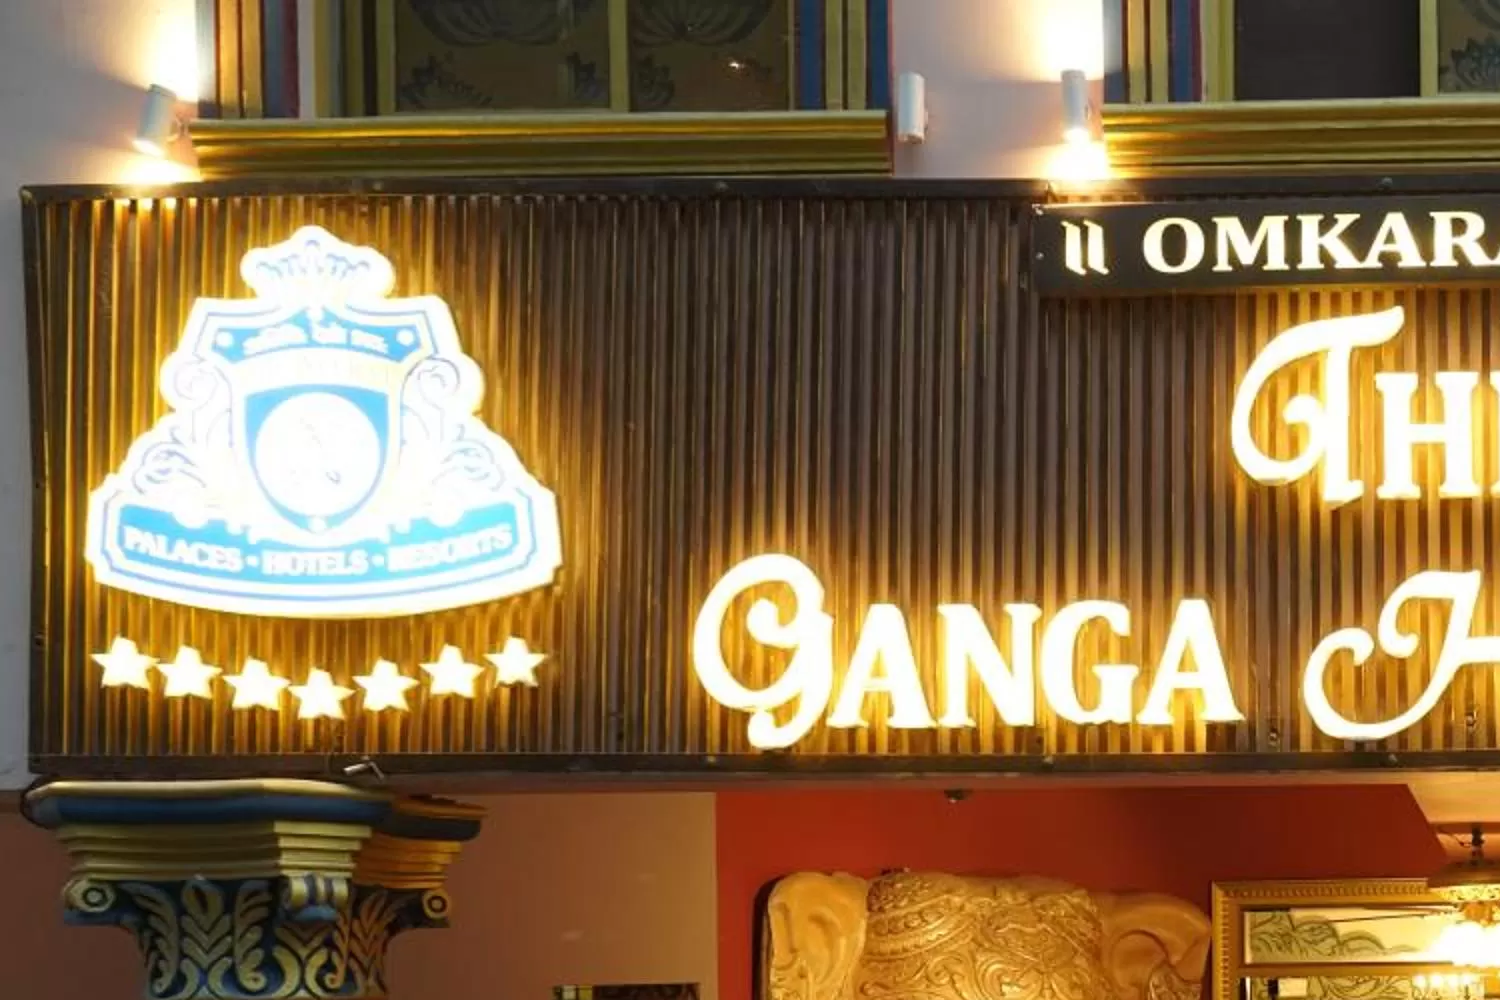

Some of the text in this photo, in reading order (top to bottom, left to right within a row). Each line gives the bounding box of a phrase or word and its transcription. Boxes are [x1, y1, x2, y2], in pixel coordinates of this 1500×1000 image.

[126, 526, 243, 571] PALACES
[262, 549, 369, 576] HOTELS
[692, 553, 1246, 751] GANGA
